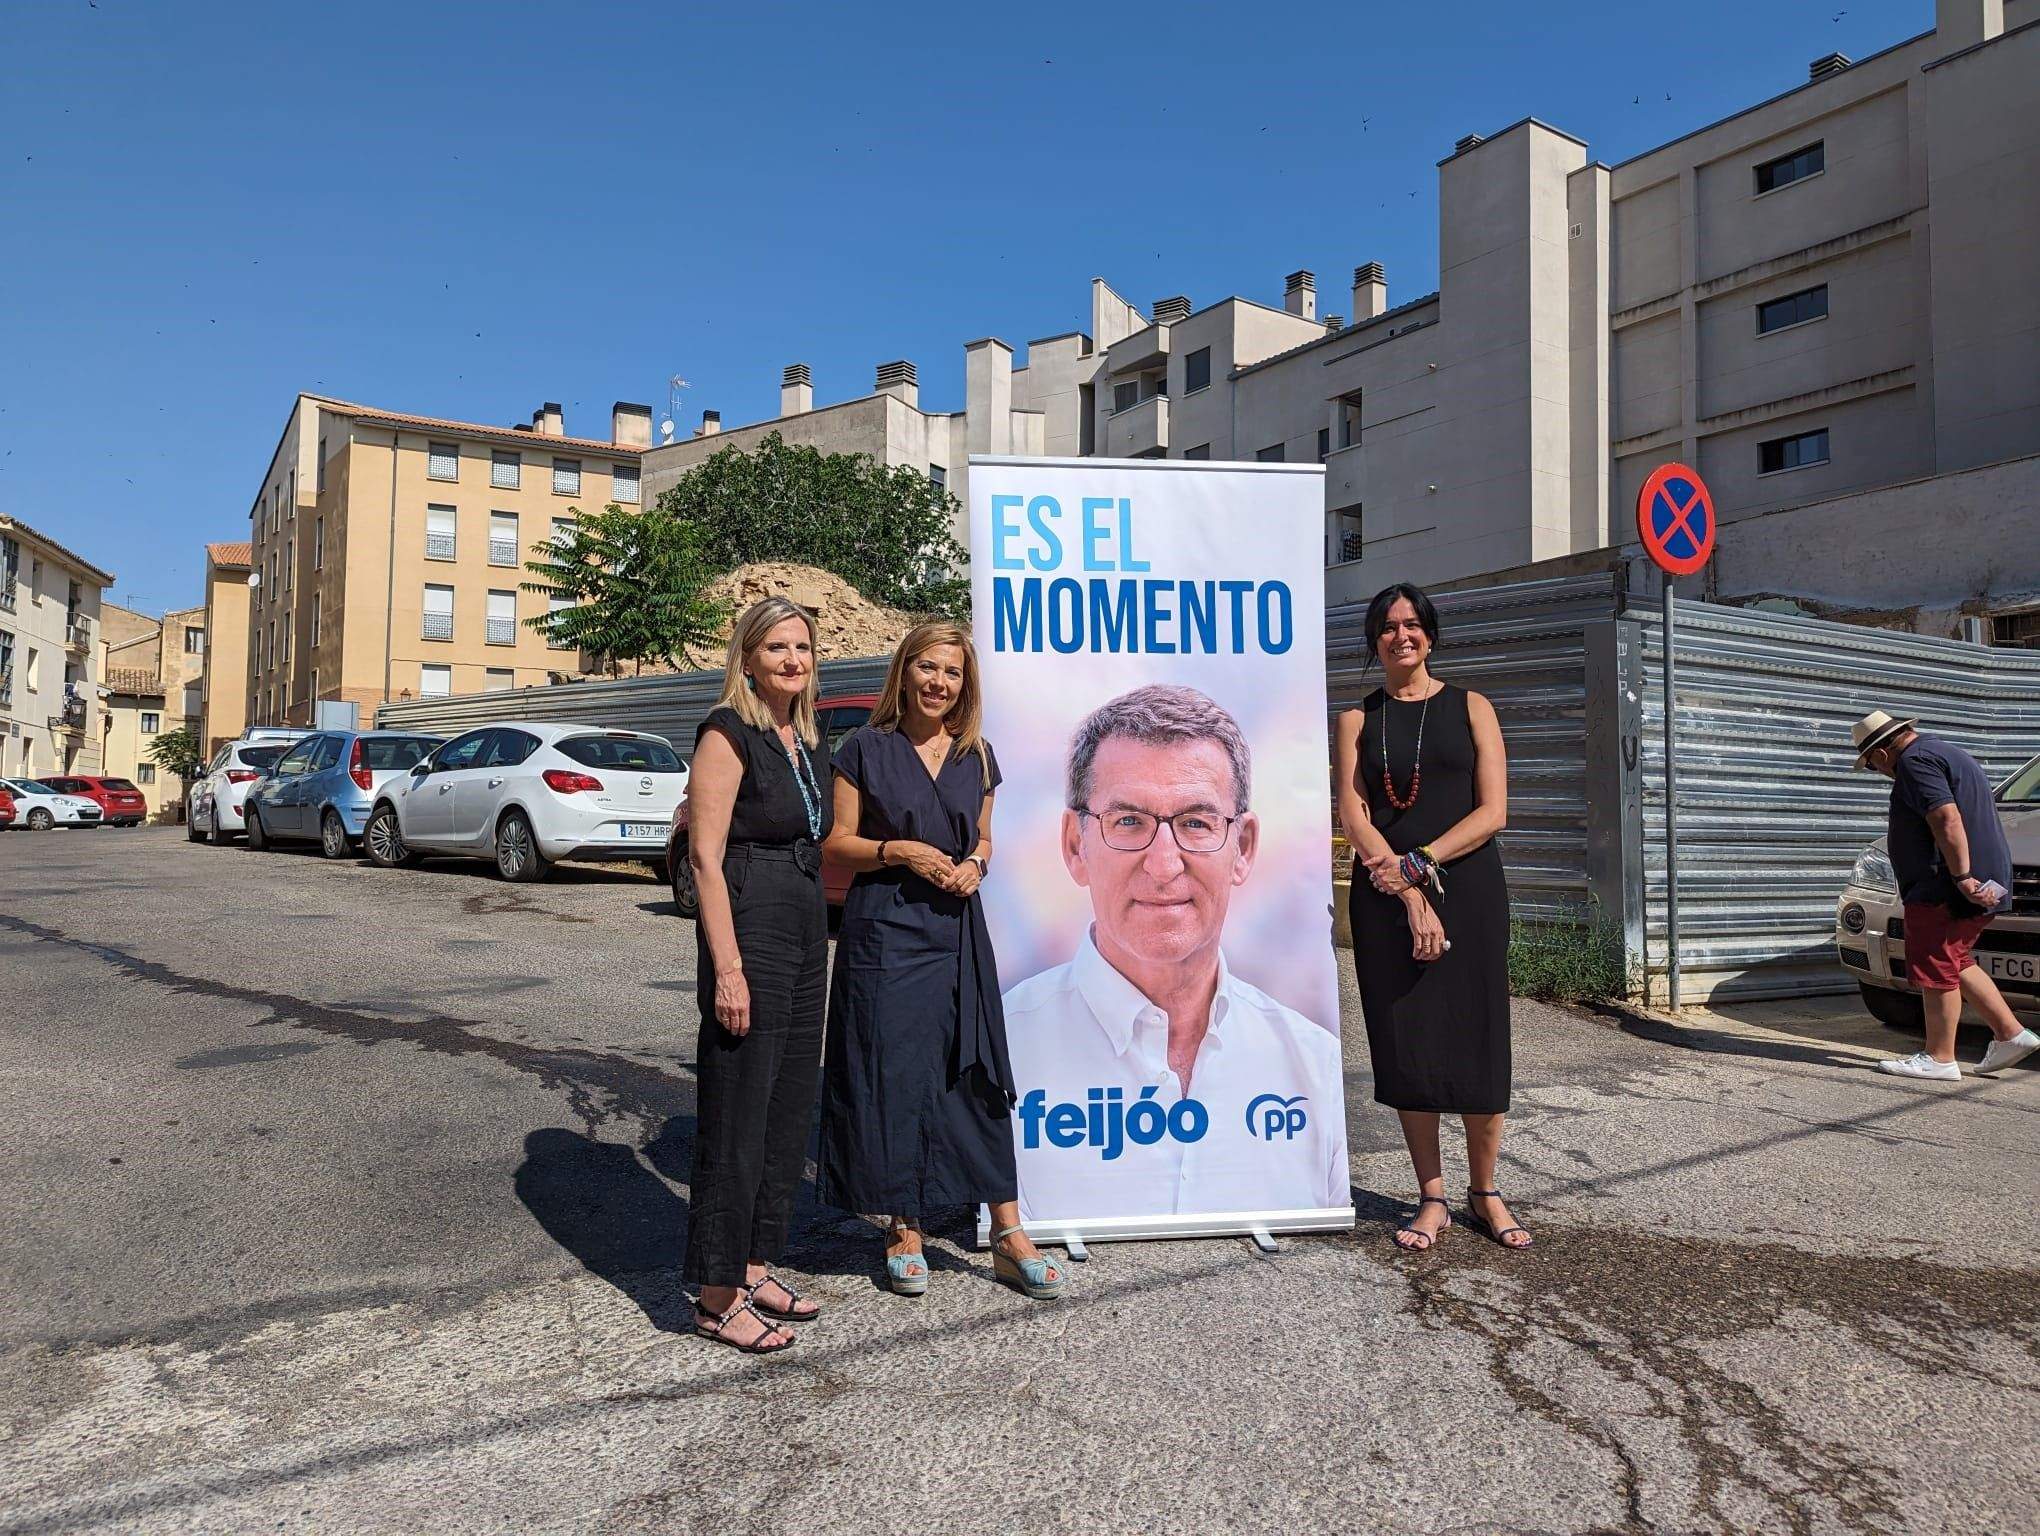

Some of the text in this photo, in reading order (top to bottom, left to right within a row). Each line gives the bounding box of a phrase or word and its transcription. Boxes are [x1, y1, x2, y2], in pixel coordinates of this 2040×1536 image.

[991, 494, 1151, 572] ES EL
[993, 576, 1294, 655] MOMENTO
[627, 825, 651, 836] 2157
[1991, 957, 2034, 978] FCG
[1018, 1086, 1209, 1161] feijóo
